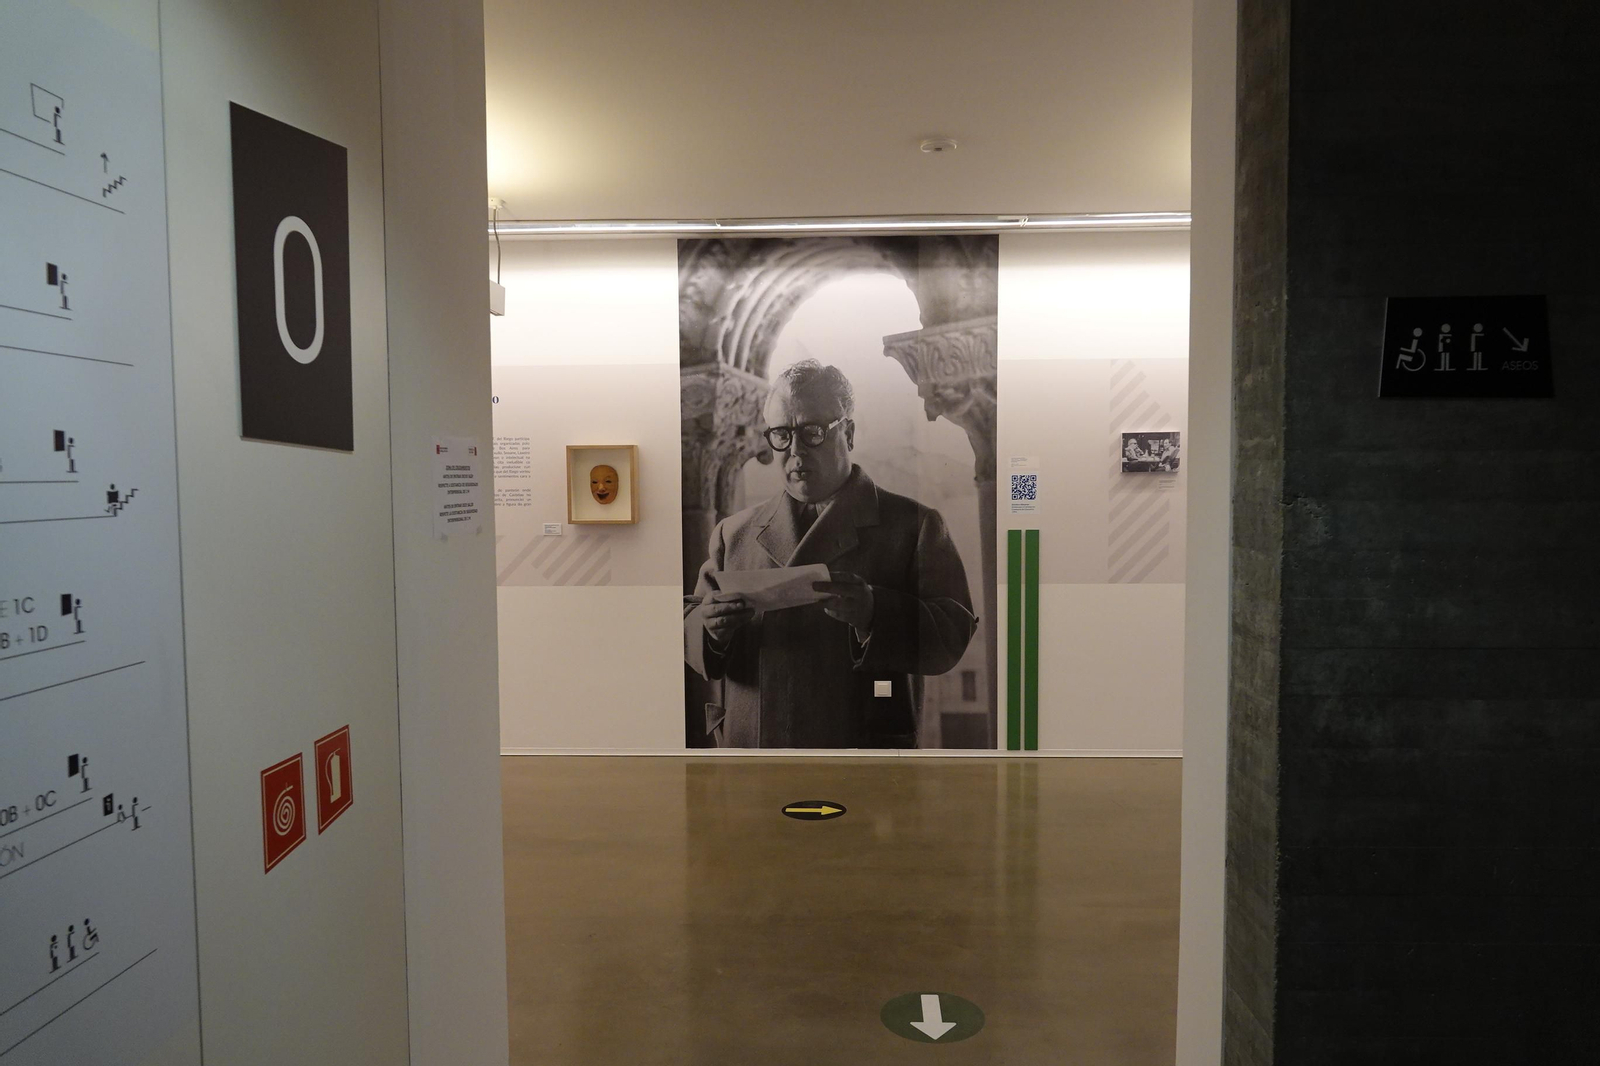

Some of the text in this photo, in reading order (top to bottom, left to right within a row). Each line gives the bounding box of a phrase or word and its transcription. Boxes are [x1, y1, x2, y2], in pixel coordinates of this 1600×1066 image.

[273, 216, 324, 364] 0
[1502, 360, 1539, 370] ASEOS
[13, 596, 35, 615] 1C
[28, 625, 49, 643] 1D
